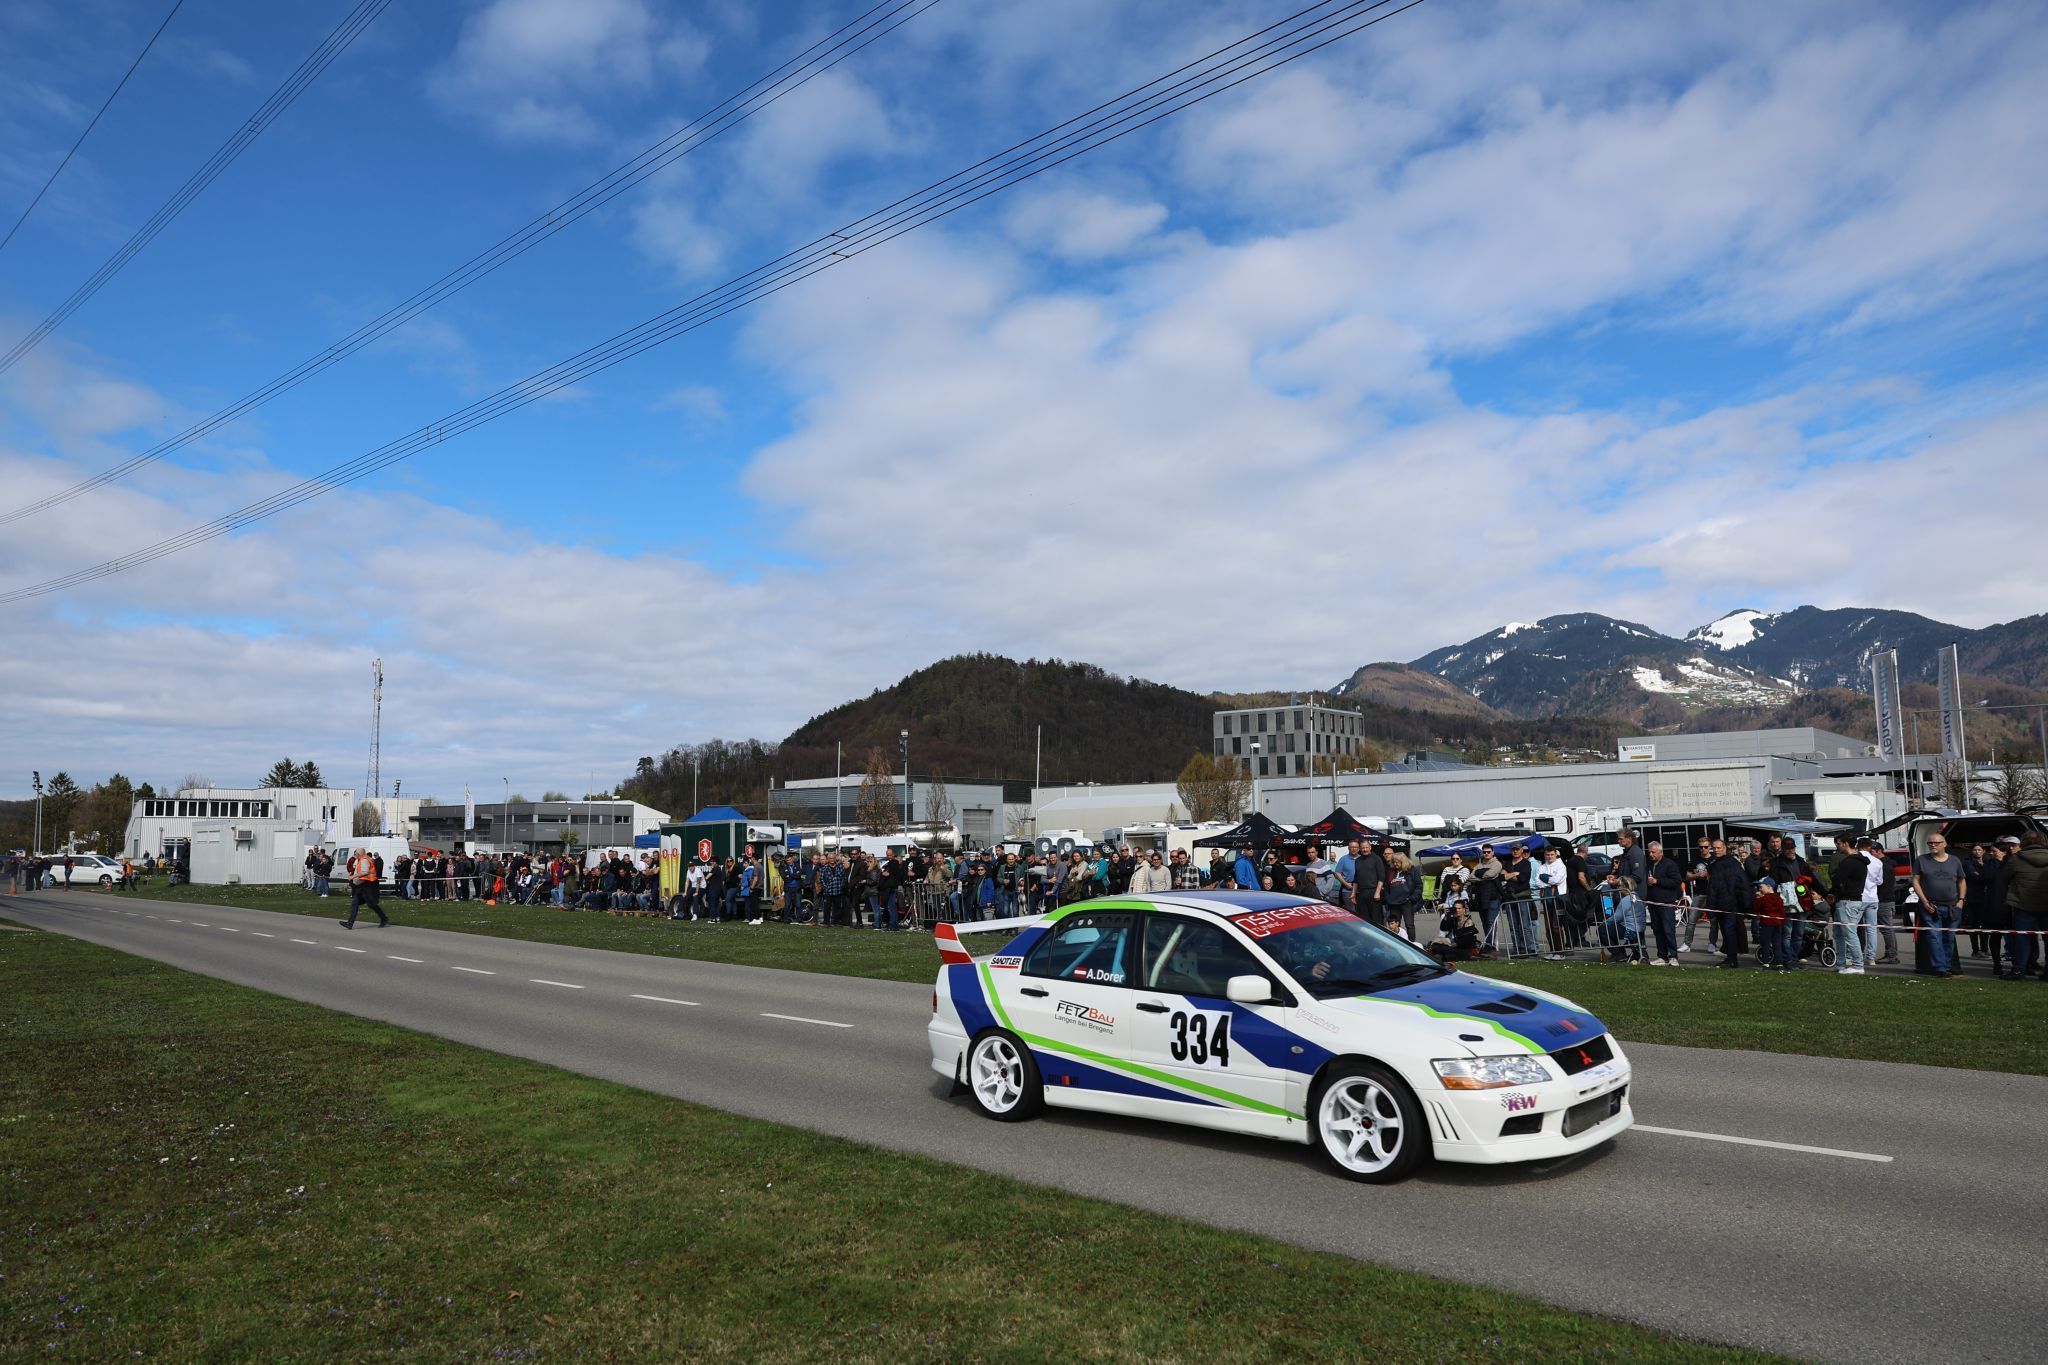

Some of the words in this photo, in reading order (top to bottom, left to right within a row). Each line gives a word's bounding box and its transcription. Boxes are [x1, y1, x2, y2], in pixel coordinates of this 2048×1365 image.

[1719, 799, 1748, 808] Training
[990, 956, 1021, 966] SANDTLER
[1086, 968, 1125, 983] A.Dorer
[1054, 1013, 1077, 1025] Langen
[1077, 1019, 1088, 1028] bei
[1088, 1021, 1114, 1034] Bregenz
[1170, 1010, 1230, 1067] 334
[1508, 1094, 1538, 1111] KW
